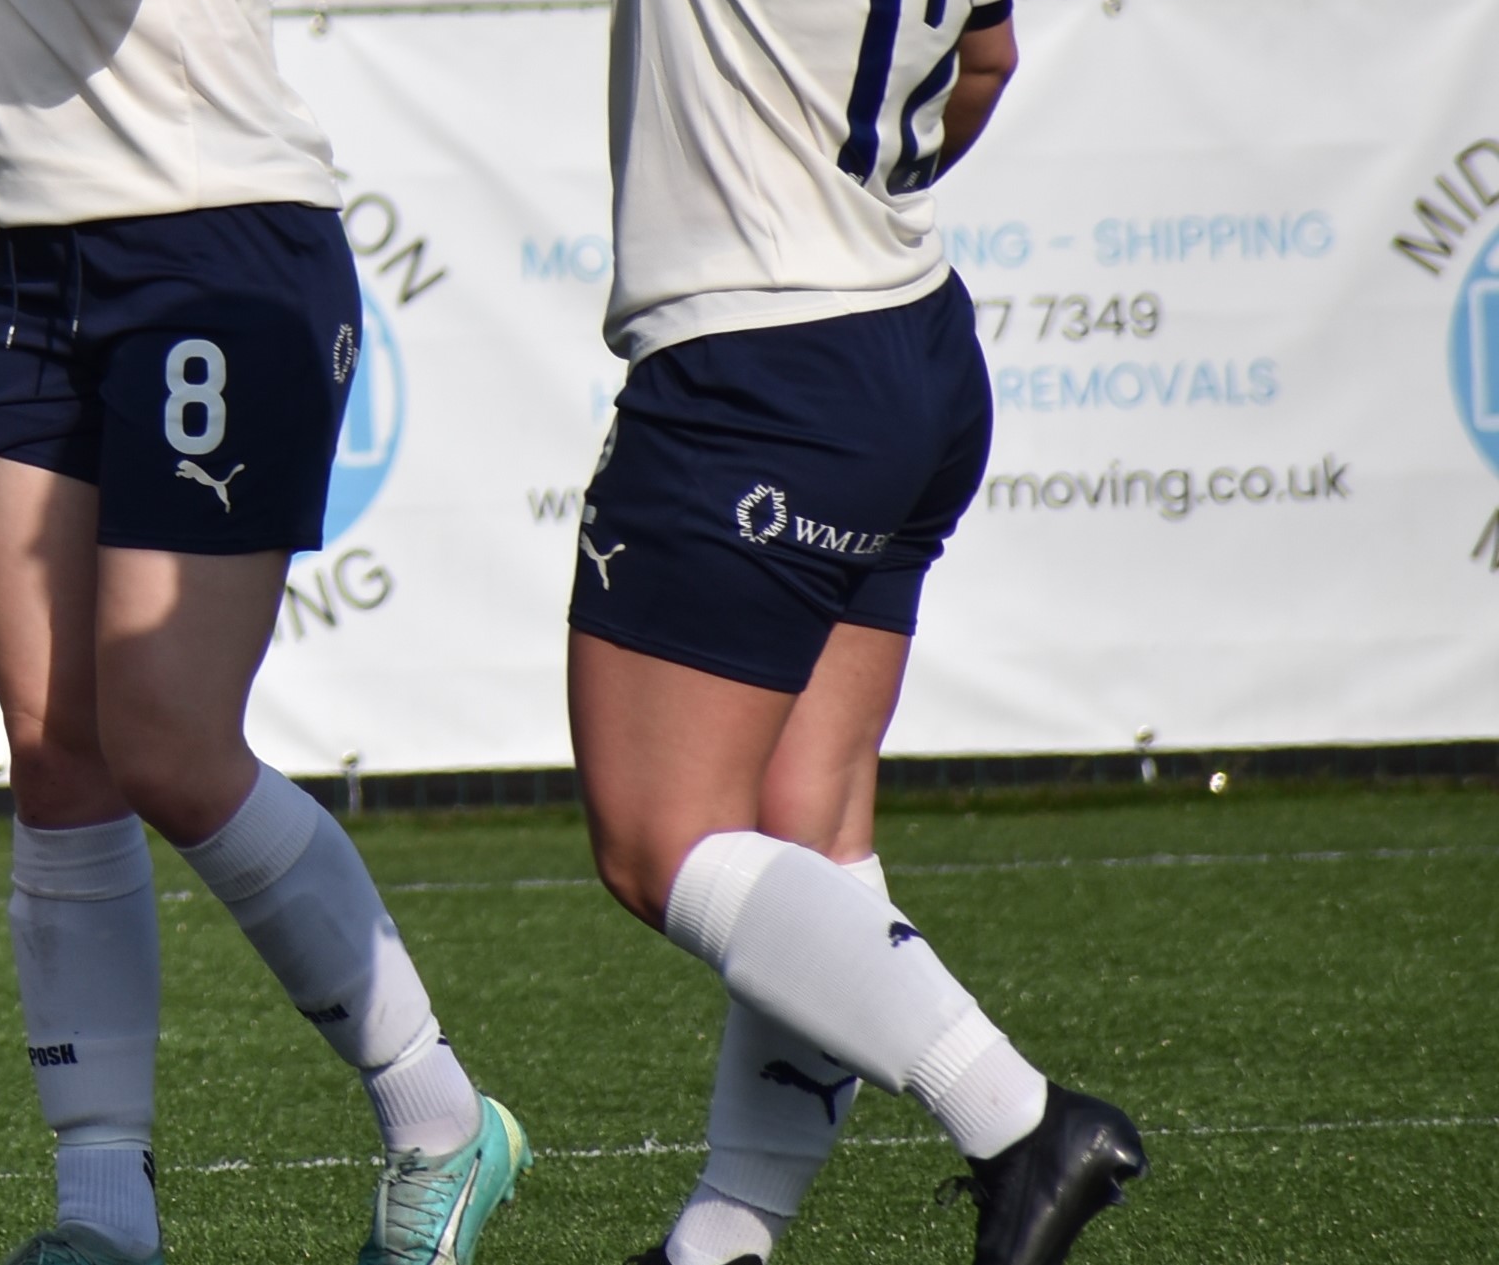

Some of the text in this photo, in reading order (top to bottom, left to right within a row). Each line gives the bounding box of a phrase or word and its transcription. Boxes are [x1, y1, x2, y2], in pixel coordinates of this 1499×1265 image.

[1092, 209, 1336, 267] SHIPPING
[1030, 291, 1162, 343] 7349
[164, 338, 227, 455] 8
[997, 355, 1279, 412] REMOVALS
[985, 452, 1353, 521] moving.co.uk
[28, 1042, 79, 1067] POSH
